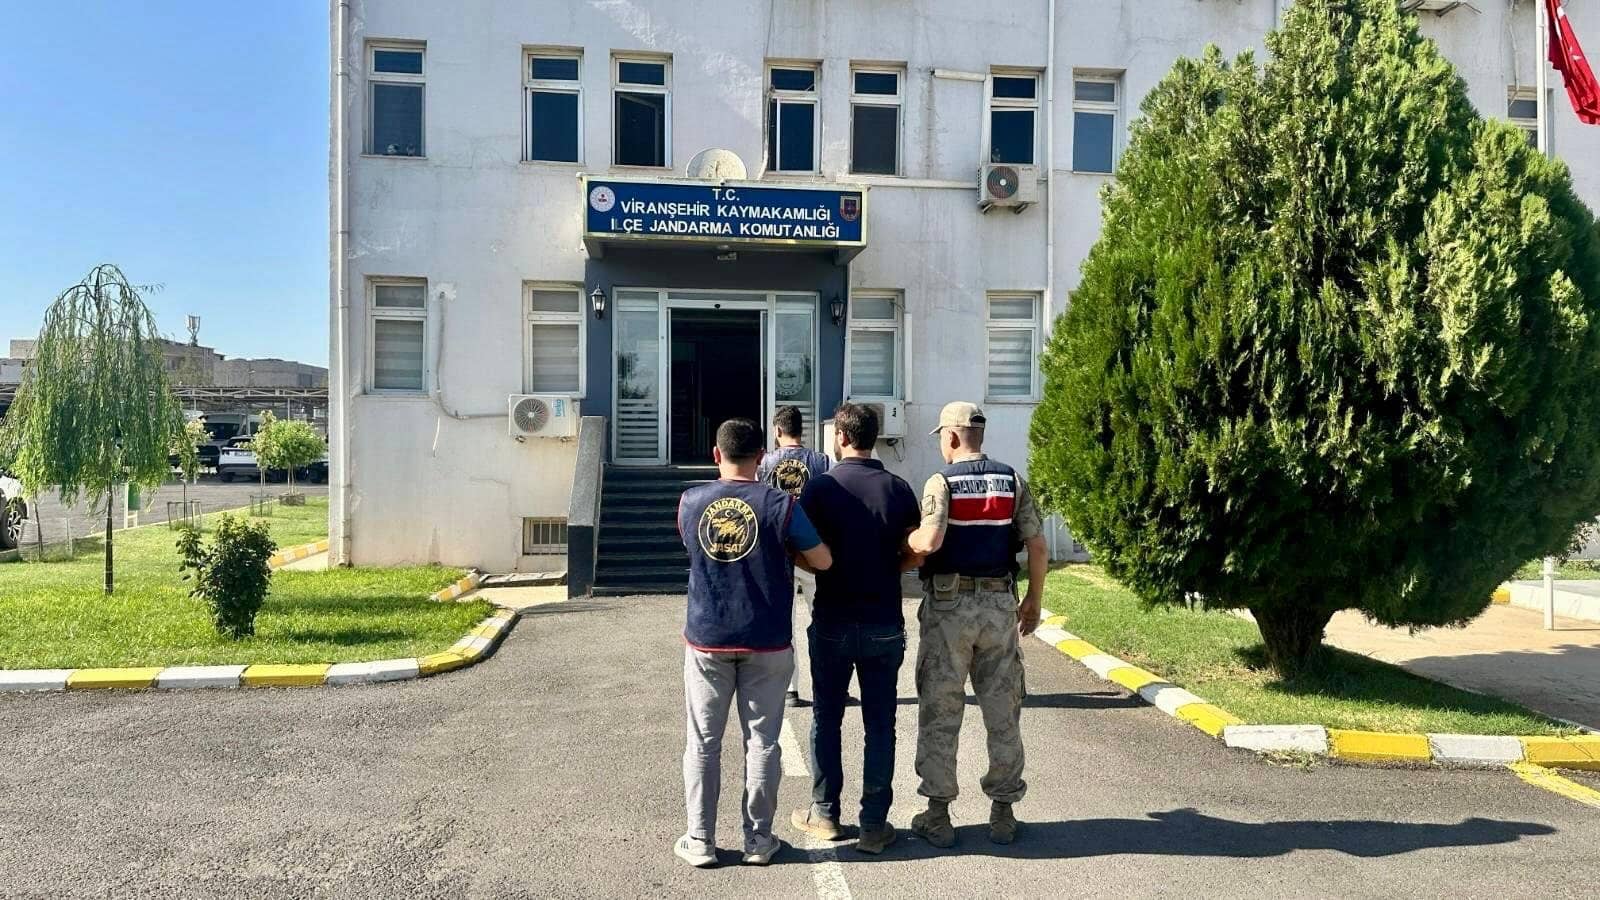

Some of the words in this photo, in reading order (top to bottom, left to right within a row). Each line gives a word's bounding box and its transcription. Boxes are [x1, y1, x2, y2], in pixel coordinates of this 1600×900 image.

[712, 188, 740, 201] T.C.
[620, 197, 710, 219] VİRANŞEHİR
[717, 204, 831, 221] KAYMAKAMLIĞI
[649, 219, 733, 235] JANDARMA
[740, 222, 840, 238] KOMUTANLIĞI
[952, 479, 1011, 494] JANDARMA
[705, 500, 754, 520] JANDARMA
[710, 543, 743, 552] JASAT
